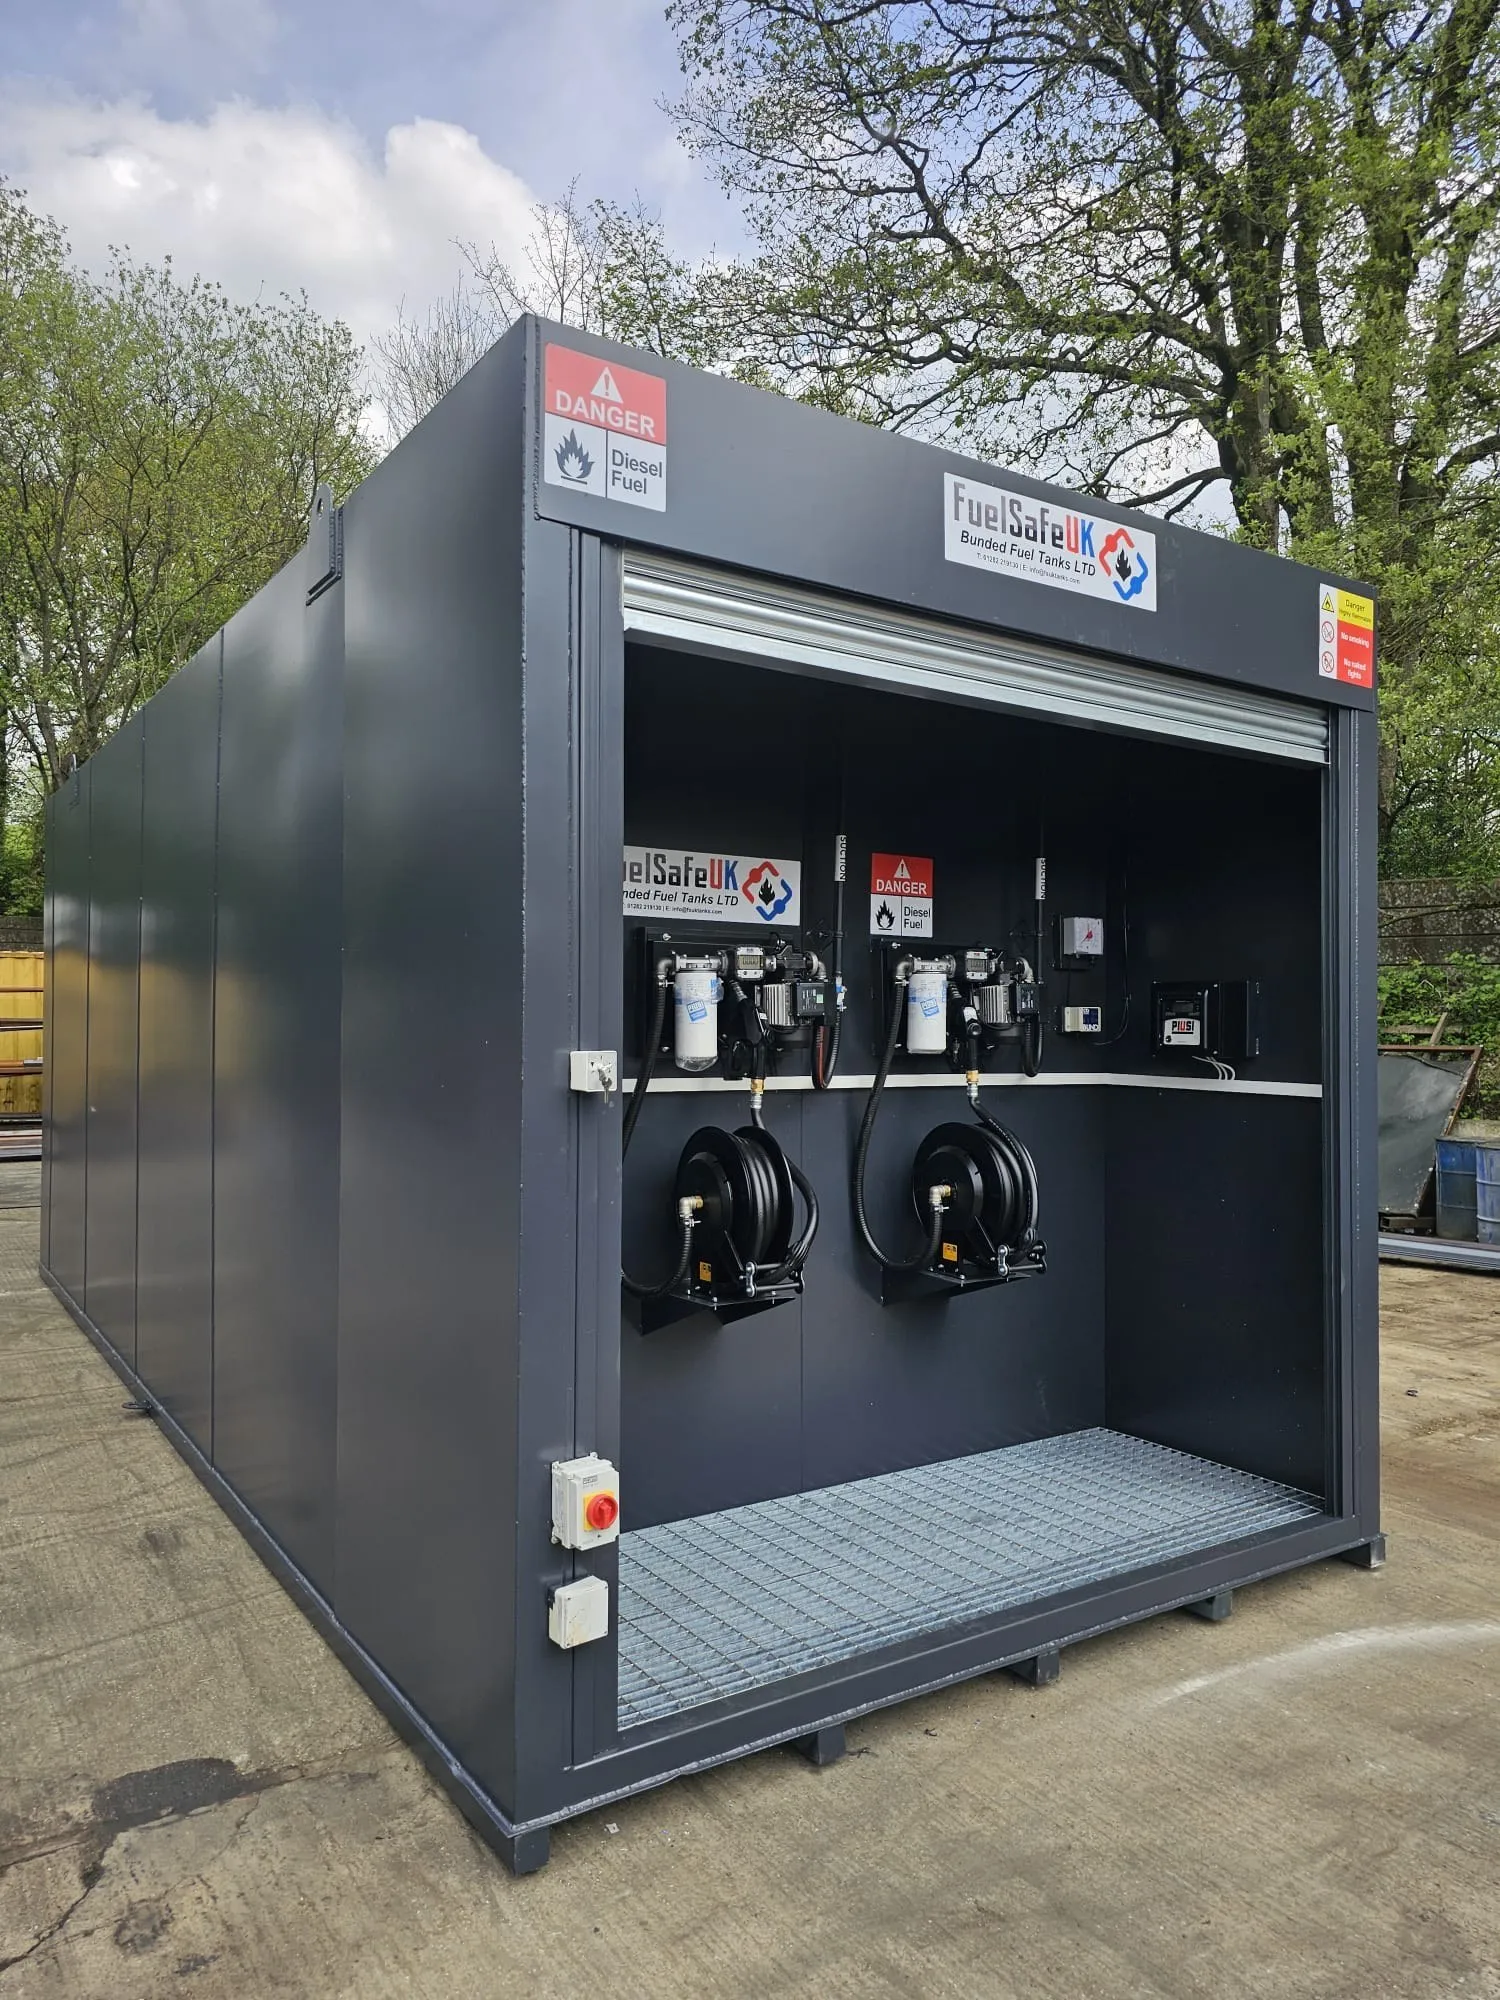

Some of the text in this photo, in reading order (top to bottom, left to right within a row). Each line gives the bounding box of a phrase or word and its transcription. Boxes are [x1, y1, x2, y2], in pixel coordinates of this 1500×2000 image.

[556, 389, 656, 438] DANGER
[612, 449, 662, 478] Diesel
[612, 470, 647, 494] Fuel
[960, 530, 1096, 576] Bunded Fuel Tanks LTD
[1345, 599, 1365, 612] Danger
[1341, 632, 1349, 641] No
[1344, 657, 1351, 667] No
[876, 879, 927, 895] DANGER
[623, 888, 739, 906] nded Fuel Tanks LTD
[904, 906, 931, 918] Diesel
[904, 919, 923, 929] Fuel
[1172, 1020, 1195, 1032] PIUSI
